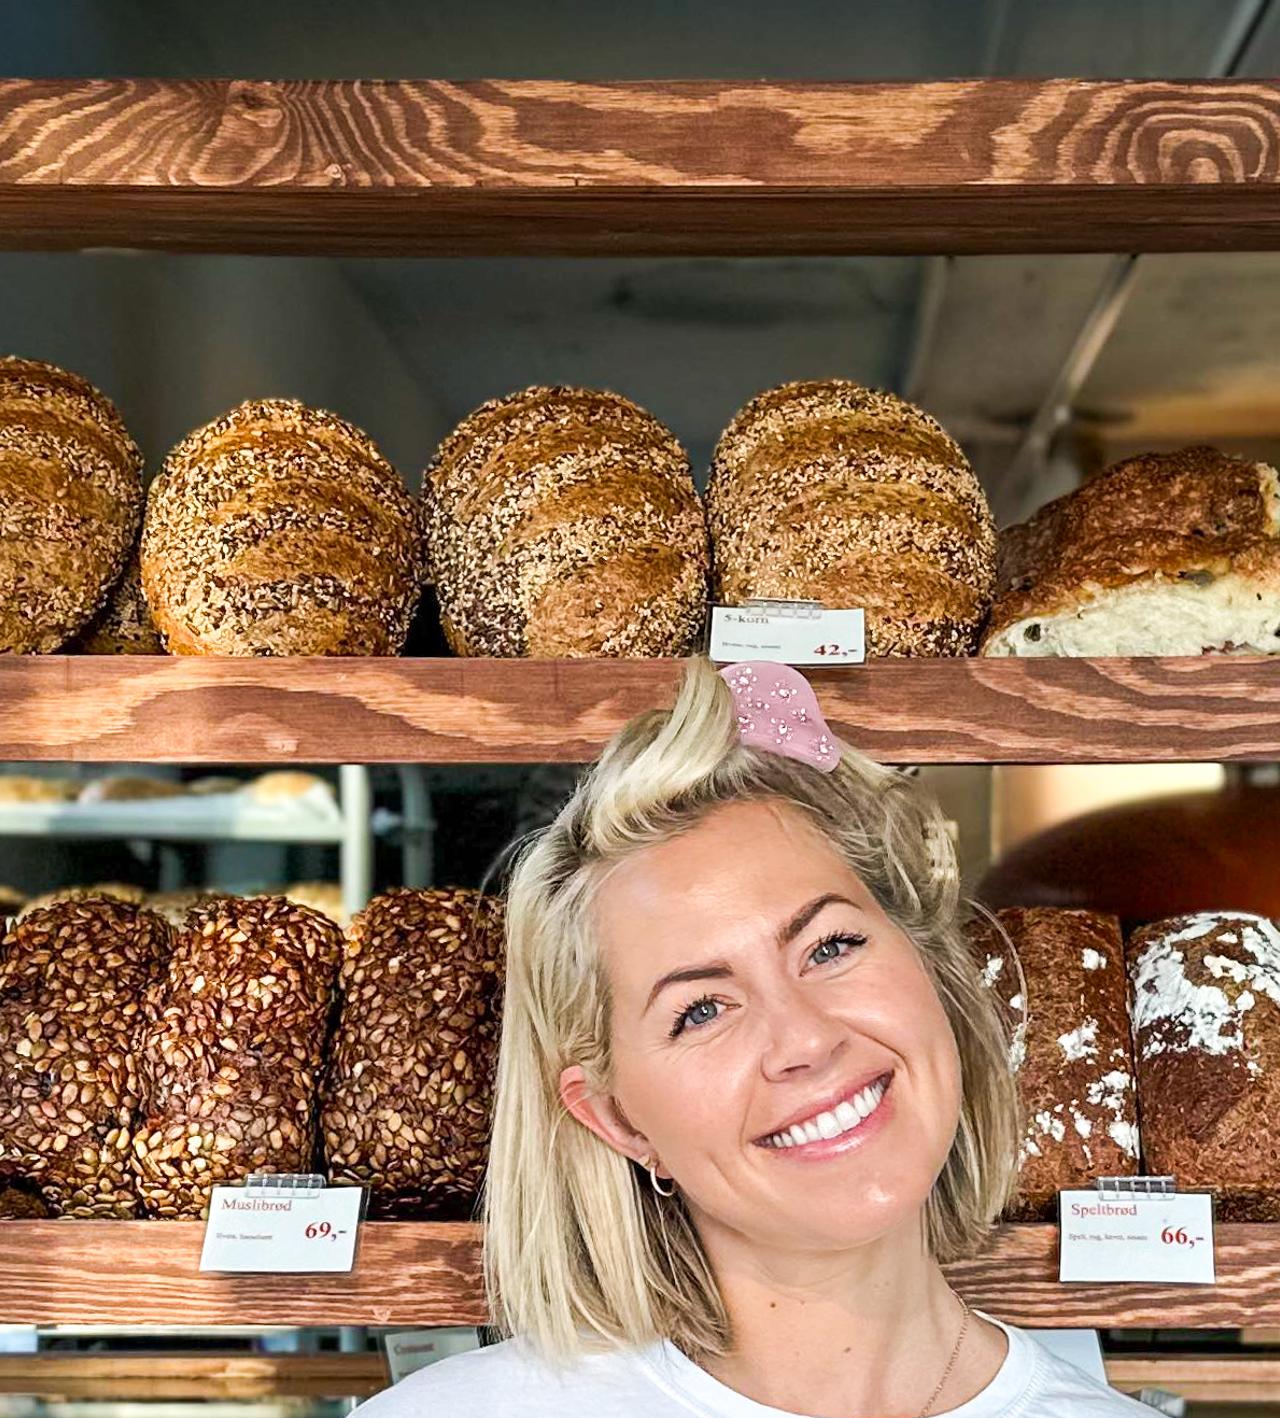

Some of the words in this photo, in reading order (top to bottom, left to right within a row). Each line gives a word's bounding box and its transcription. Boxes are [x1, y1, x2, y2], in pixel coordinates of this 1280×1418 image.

[814, 644, 858, 657] 42,-
[1071, 1203, 1138, 1218] Speltbrød
[304, 1221, 348, 1242] 69,-
[1161, 1225, 1205, 1248] 66,-
